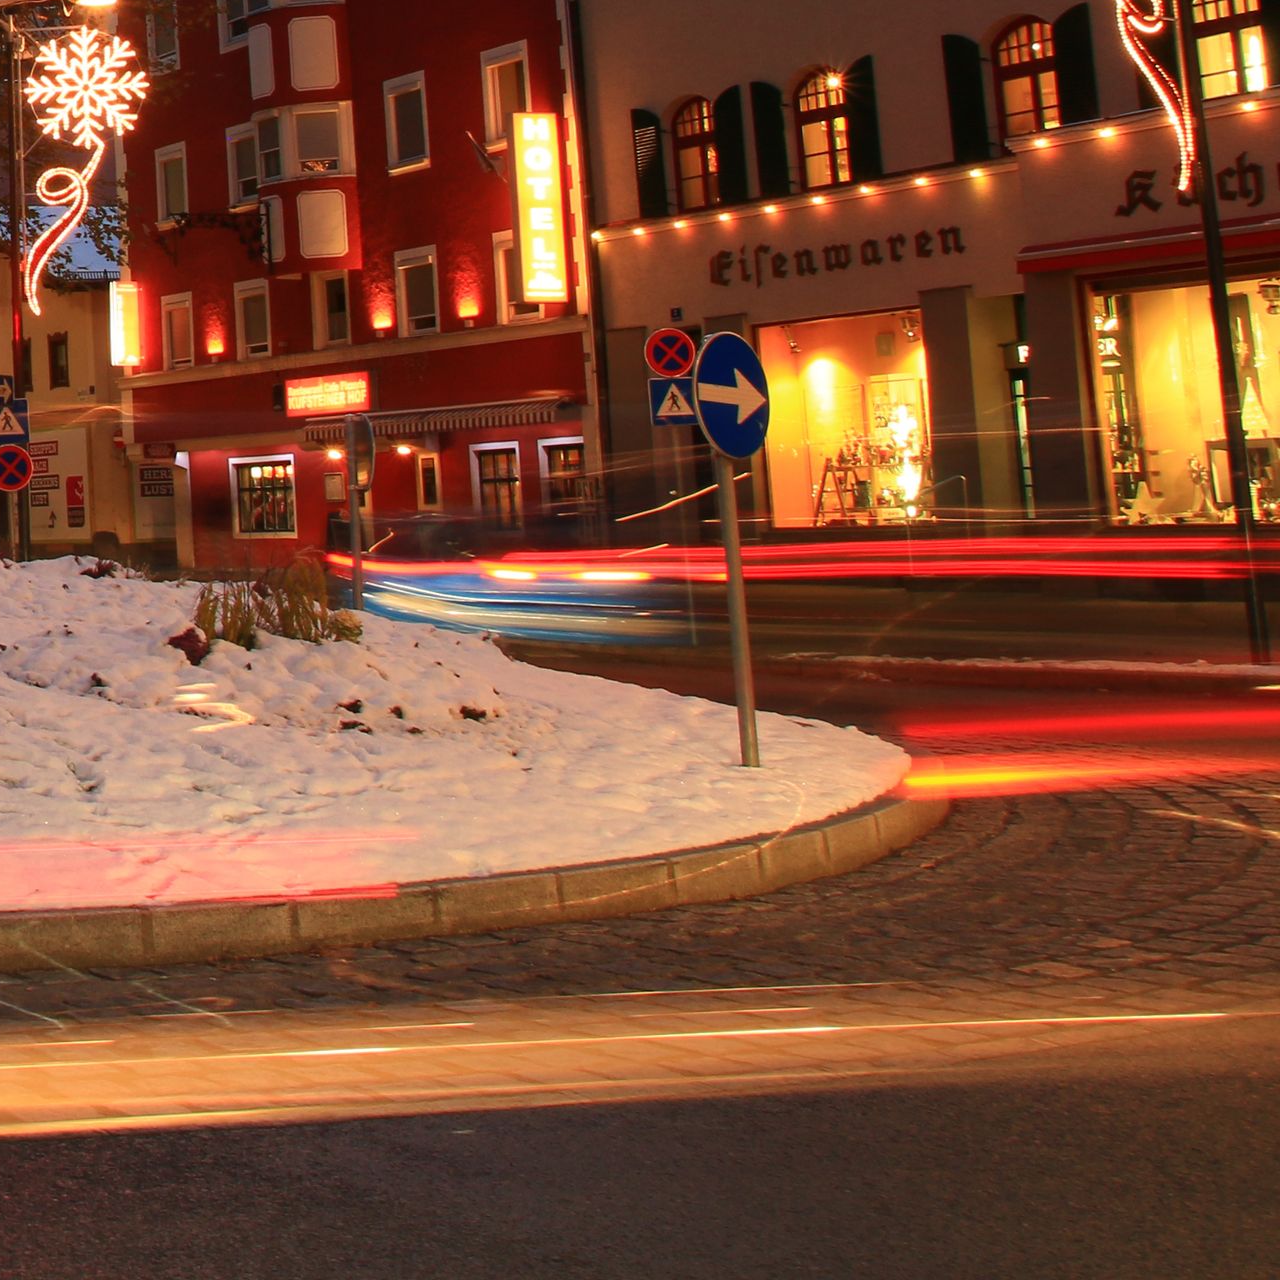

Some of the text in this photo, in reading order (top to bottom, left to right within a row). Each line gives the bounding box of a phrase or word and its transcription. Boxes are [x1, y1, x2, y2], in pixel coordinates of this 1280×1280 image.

[522, 117, 557, 261] HOTEL
[287, 390, 367, 410] KUFSTEINER HOF
